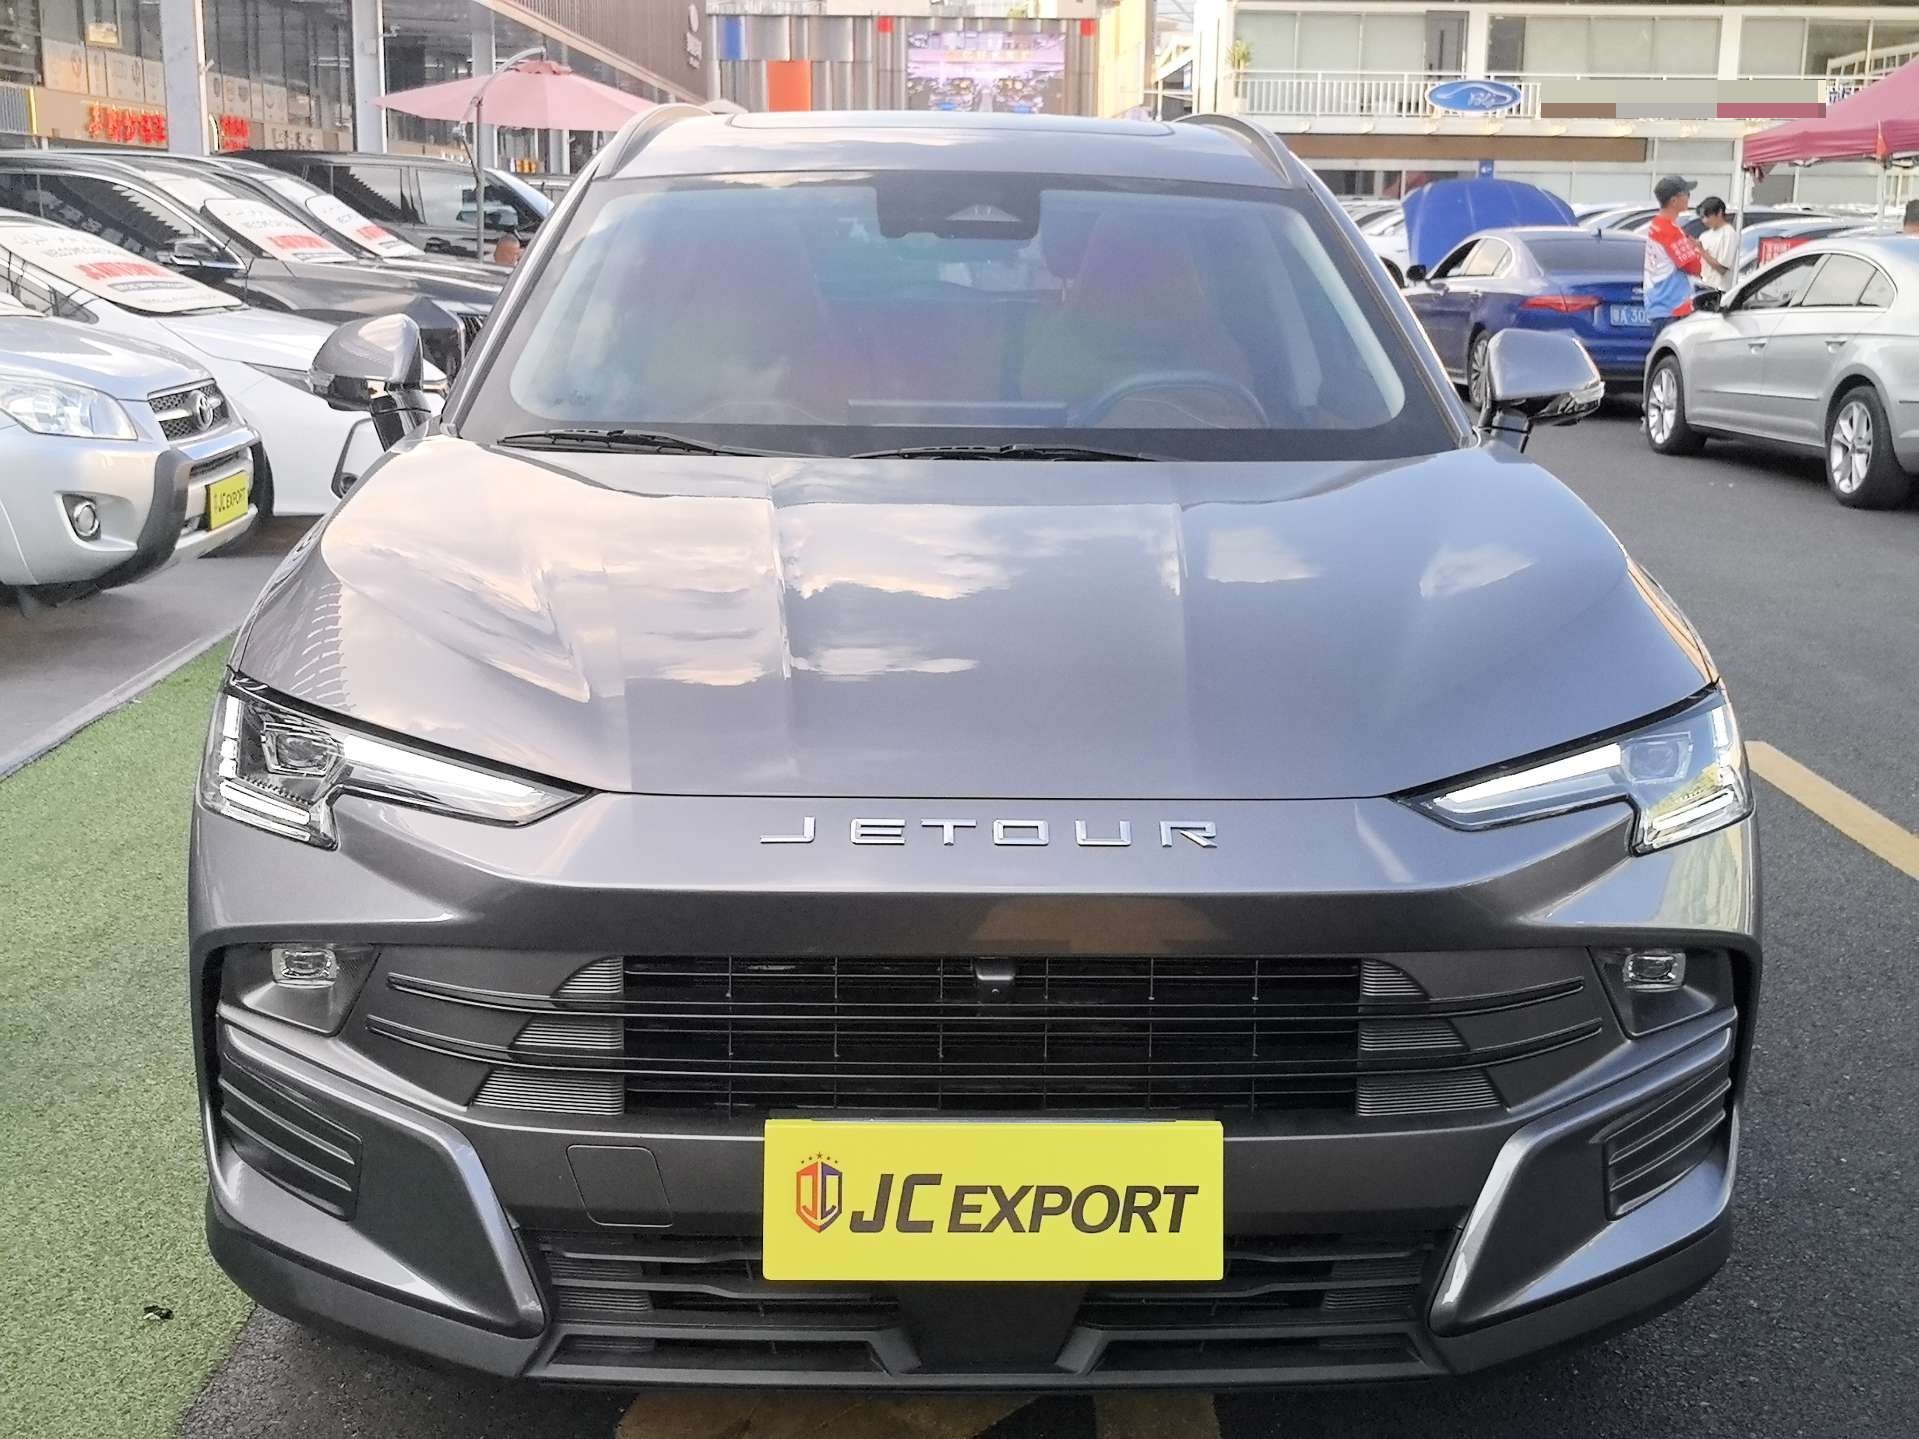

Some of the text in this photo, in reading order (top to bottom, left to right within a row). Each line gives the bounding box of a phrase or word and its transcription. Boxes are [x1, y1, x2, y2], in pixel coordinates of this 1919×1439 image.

[760, 816, 1218, 849] JETOUR
[849, 1173, 1200, 1234] JC EXPORT
